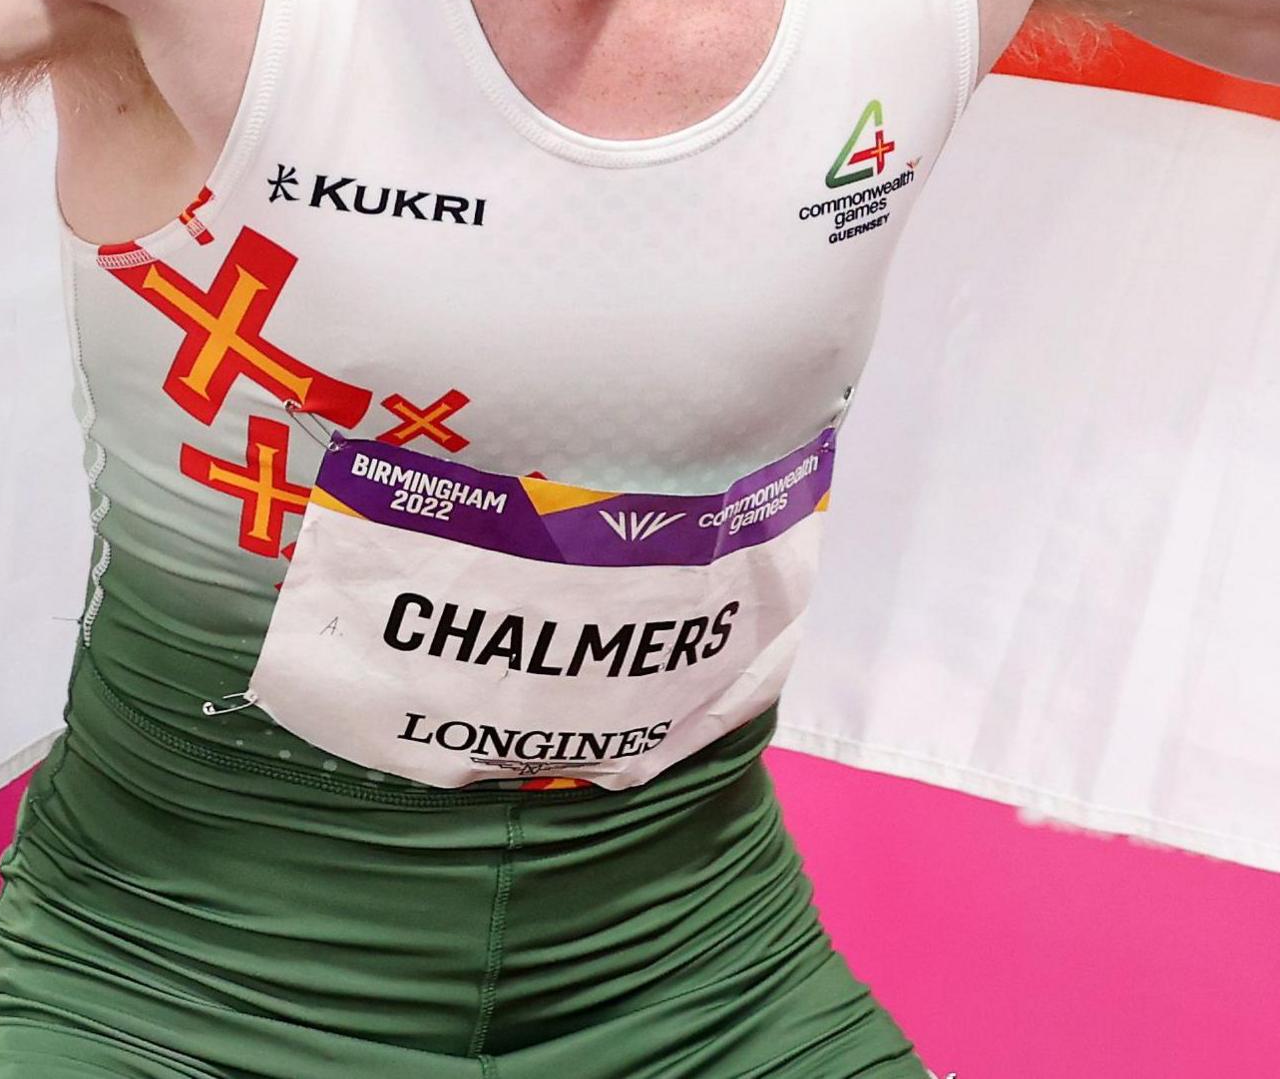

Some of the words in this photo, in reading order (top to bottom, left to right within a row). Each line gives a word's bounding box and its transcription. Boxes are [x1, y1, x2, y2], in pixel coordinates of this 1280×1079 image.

[309, 175, 486, 226] KUKRI
[799, 170, 914, 220] commonwealth
[834, 197, 887, 229] games
[828, 213, 890, 244] GUERNSEY
[351, 453, 507, 514] BIRMINGHAM
[390, 489, 454, 521] 2022
[698, 454, 818, 528] commonwealth
[728, 492, 788, 535] games
[383, 592, 739, 677] CHALMERS
[397, 712, 672, 760] LONGINES
